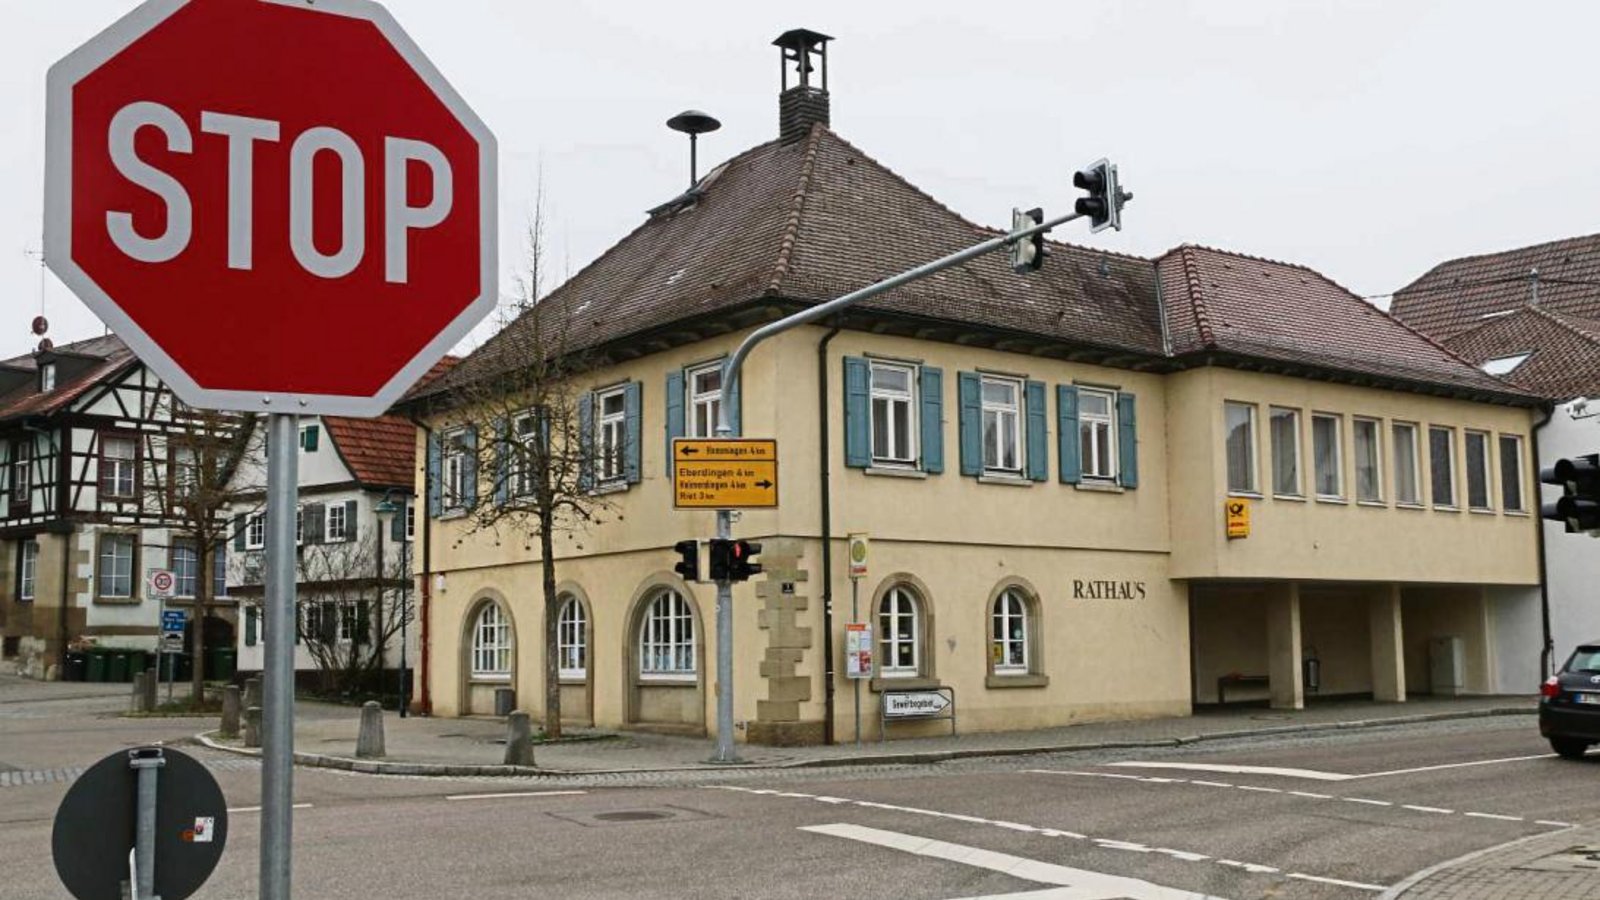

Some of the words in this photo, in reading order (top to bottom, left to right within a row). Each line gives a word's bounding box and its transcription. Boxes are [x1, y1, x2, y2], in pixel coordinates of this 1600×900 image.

[106, 101, 453, 284] STOP
[679, 468, 734, 479] Eberdingen
[736, 468, 743, 477] 4
[744, 468, 755, 477] km
[679, 492, 696, 500] Riet
[1073, 579, 1146, 600] RATHAUS
